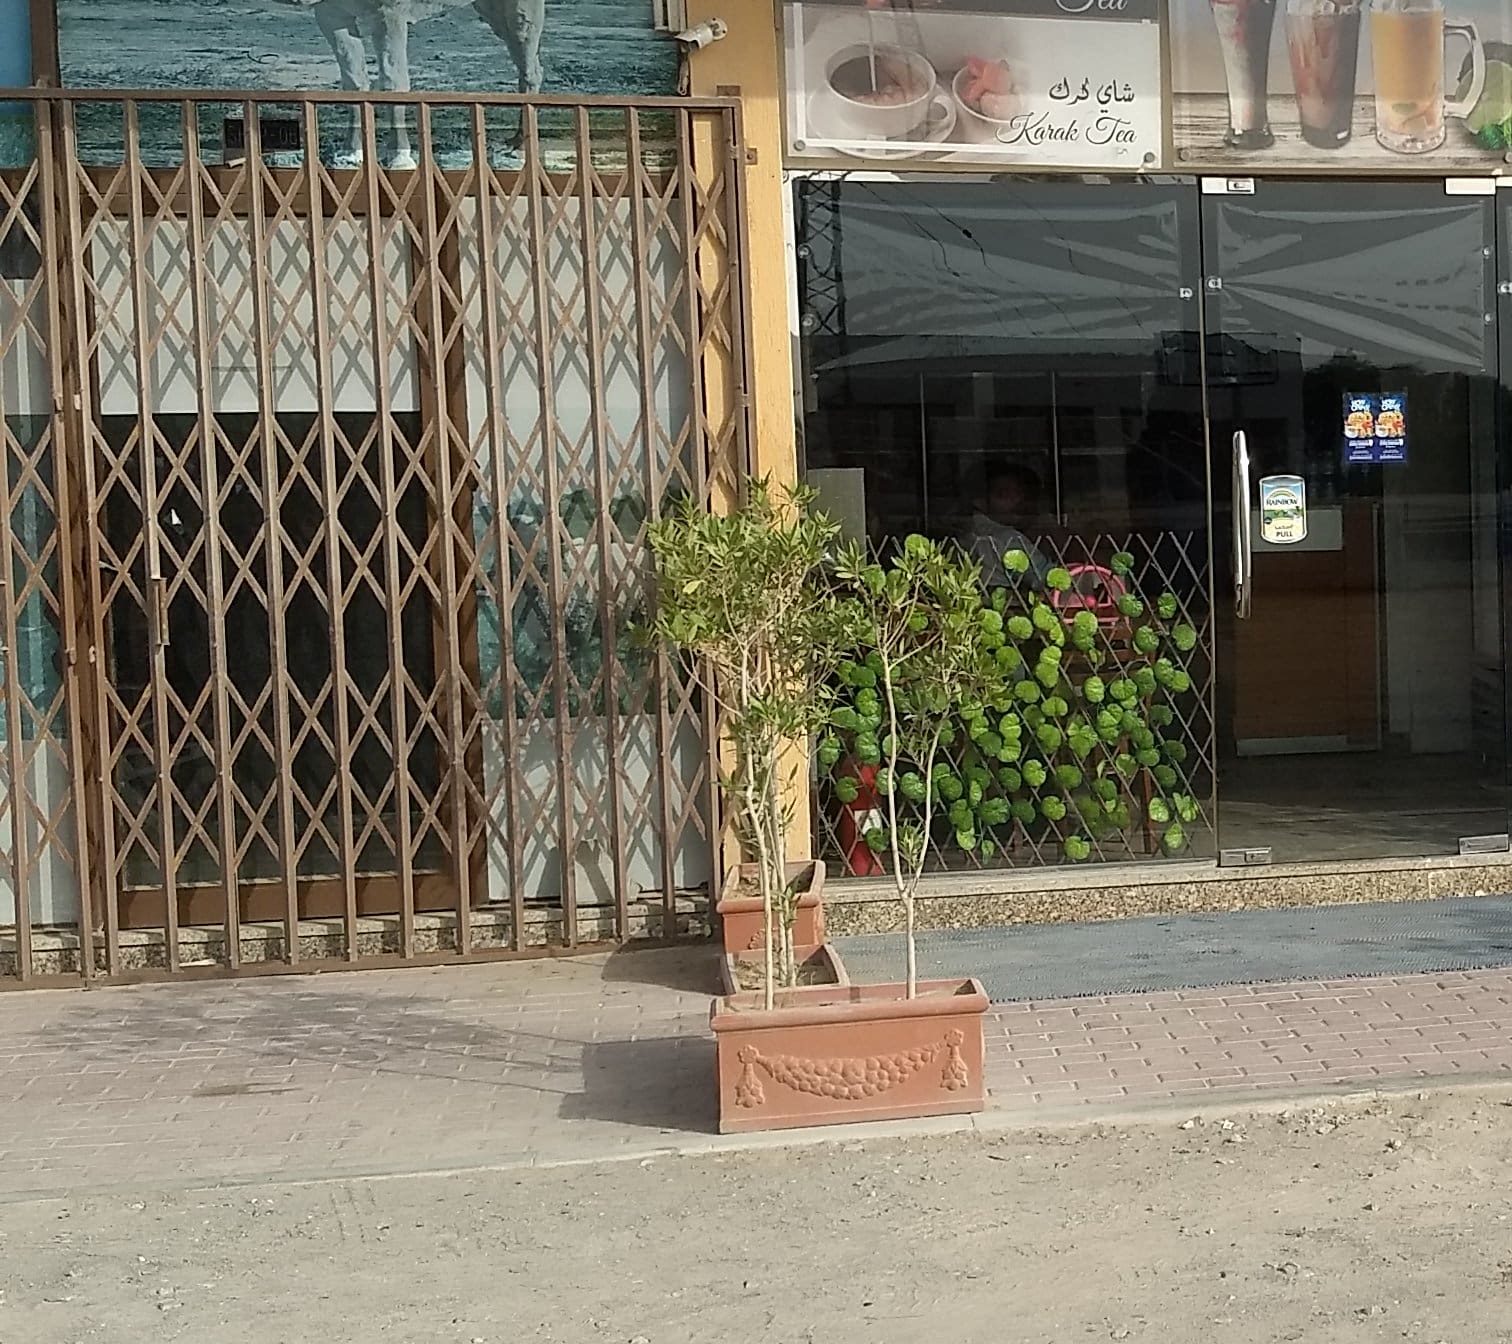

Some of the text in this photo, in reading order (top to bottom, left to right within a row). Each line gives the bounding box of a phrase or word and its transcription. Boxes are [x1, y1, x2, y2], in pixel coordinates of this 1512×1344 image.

[1096, 79, 1135, 114] شاي
[995, 111, 1138, 145] Karak Tea
[1266, 498, 1298, 506] RAINBOW
